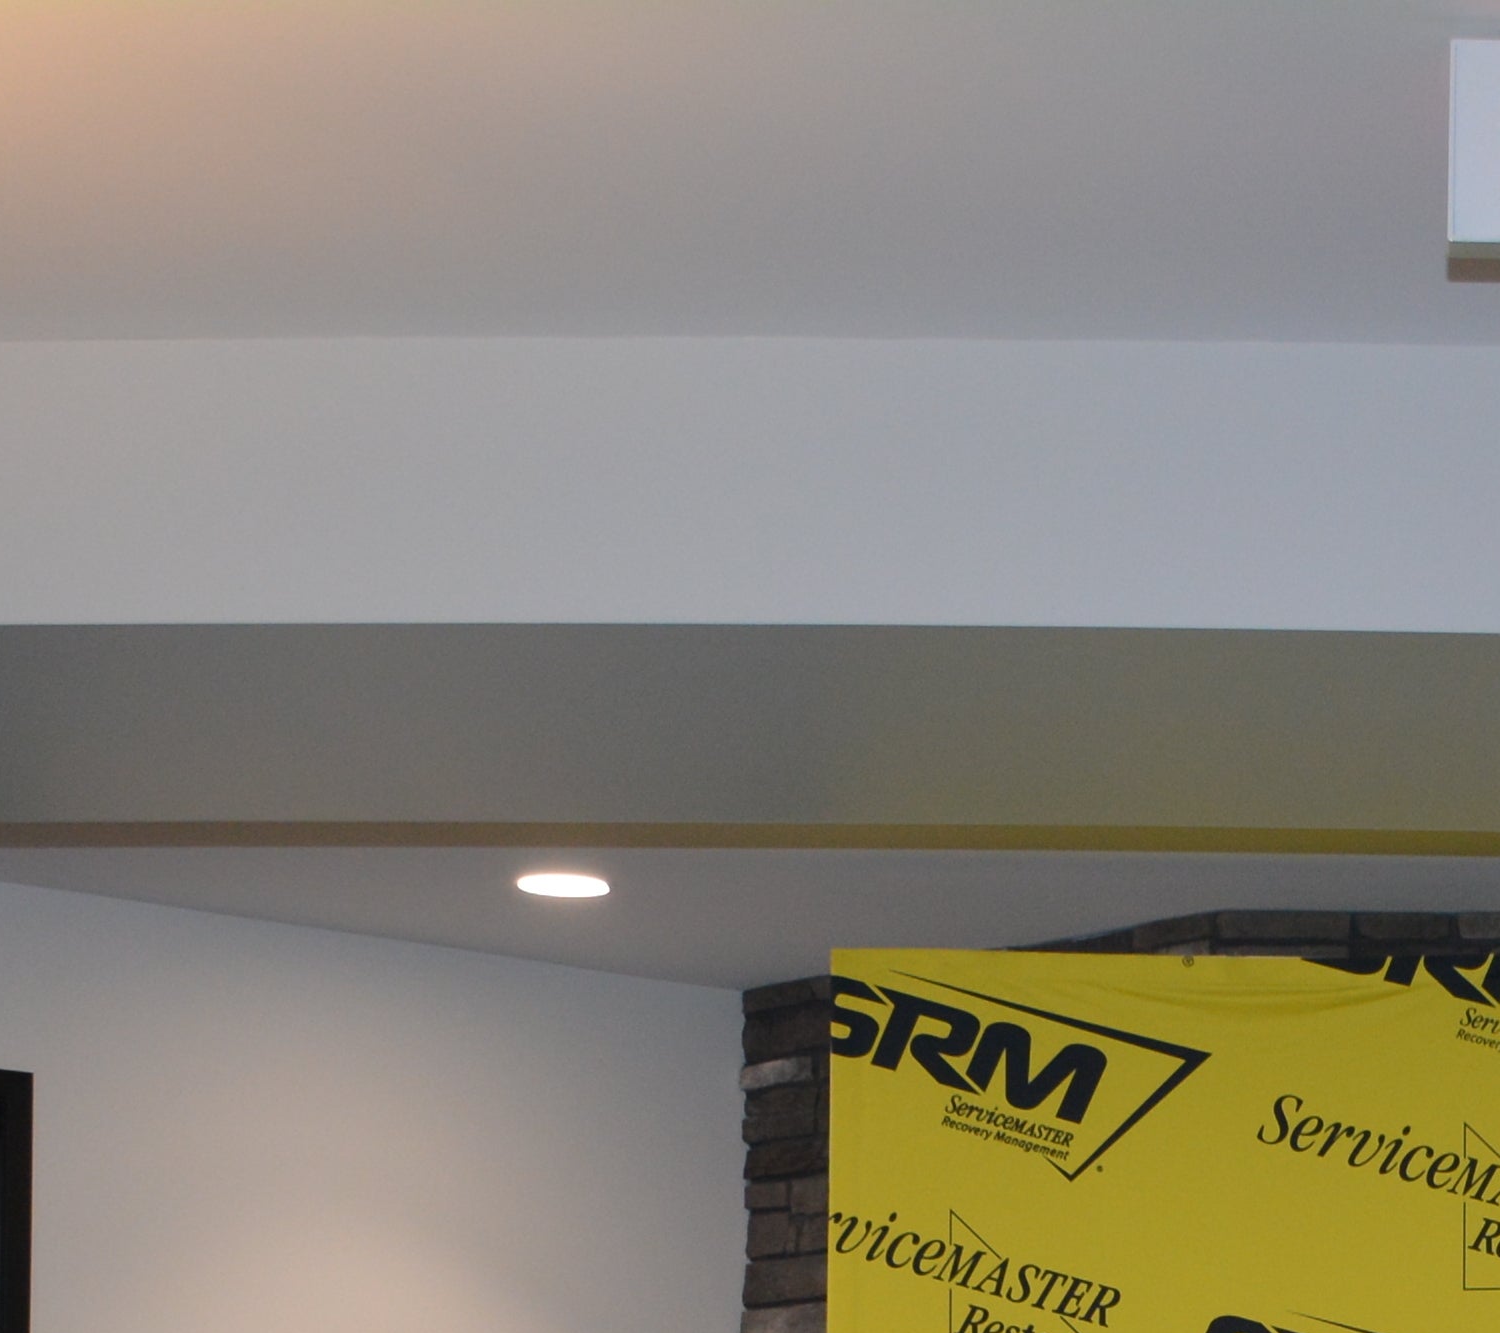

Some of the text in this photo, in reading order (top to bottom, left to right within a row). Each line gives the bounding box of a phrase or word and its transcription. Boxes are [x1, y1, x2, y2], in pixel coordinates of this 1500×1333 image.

[830, 974, 1108, 1124] SRM
[942, 1116, 1069, 1161] Recovery Management
[945, 1094, 1074, 1147] ServiceMASTER
